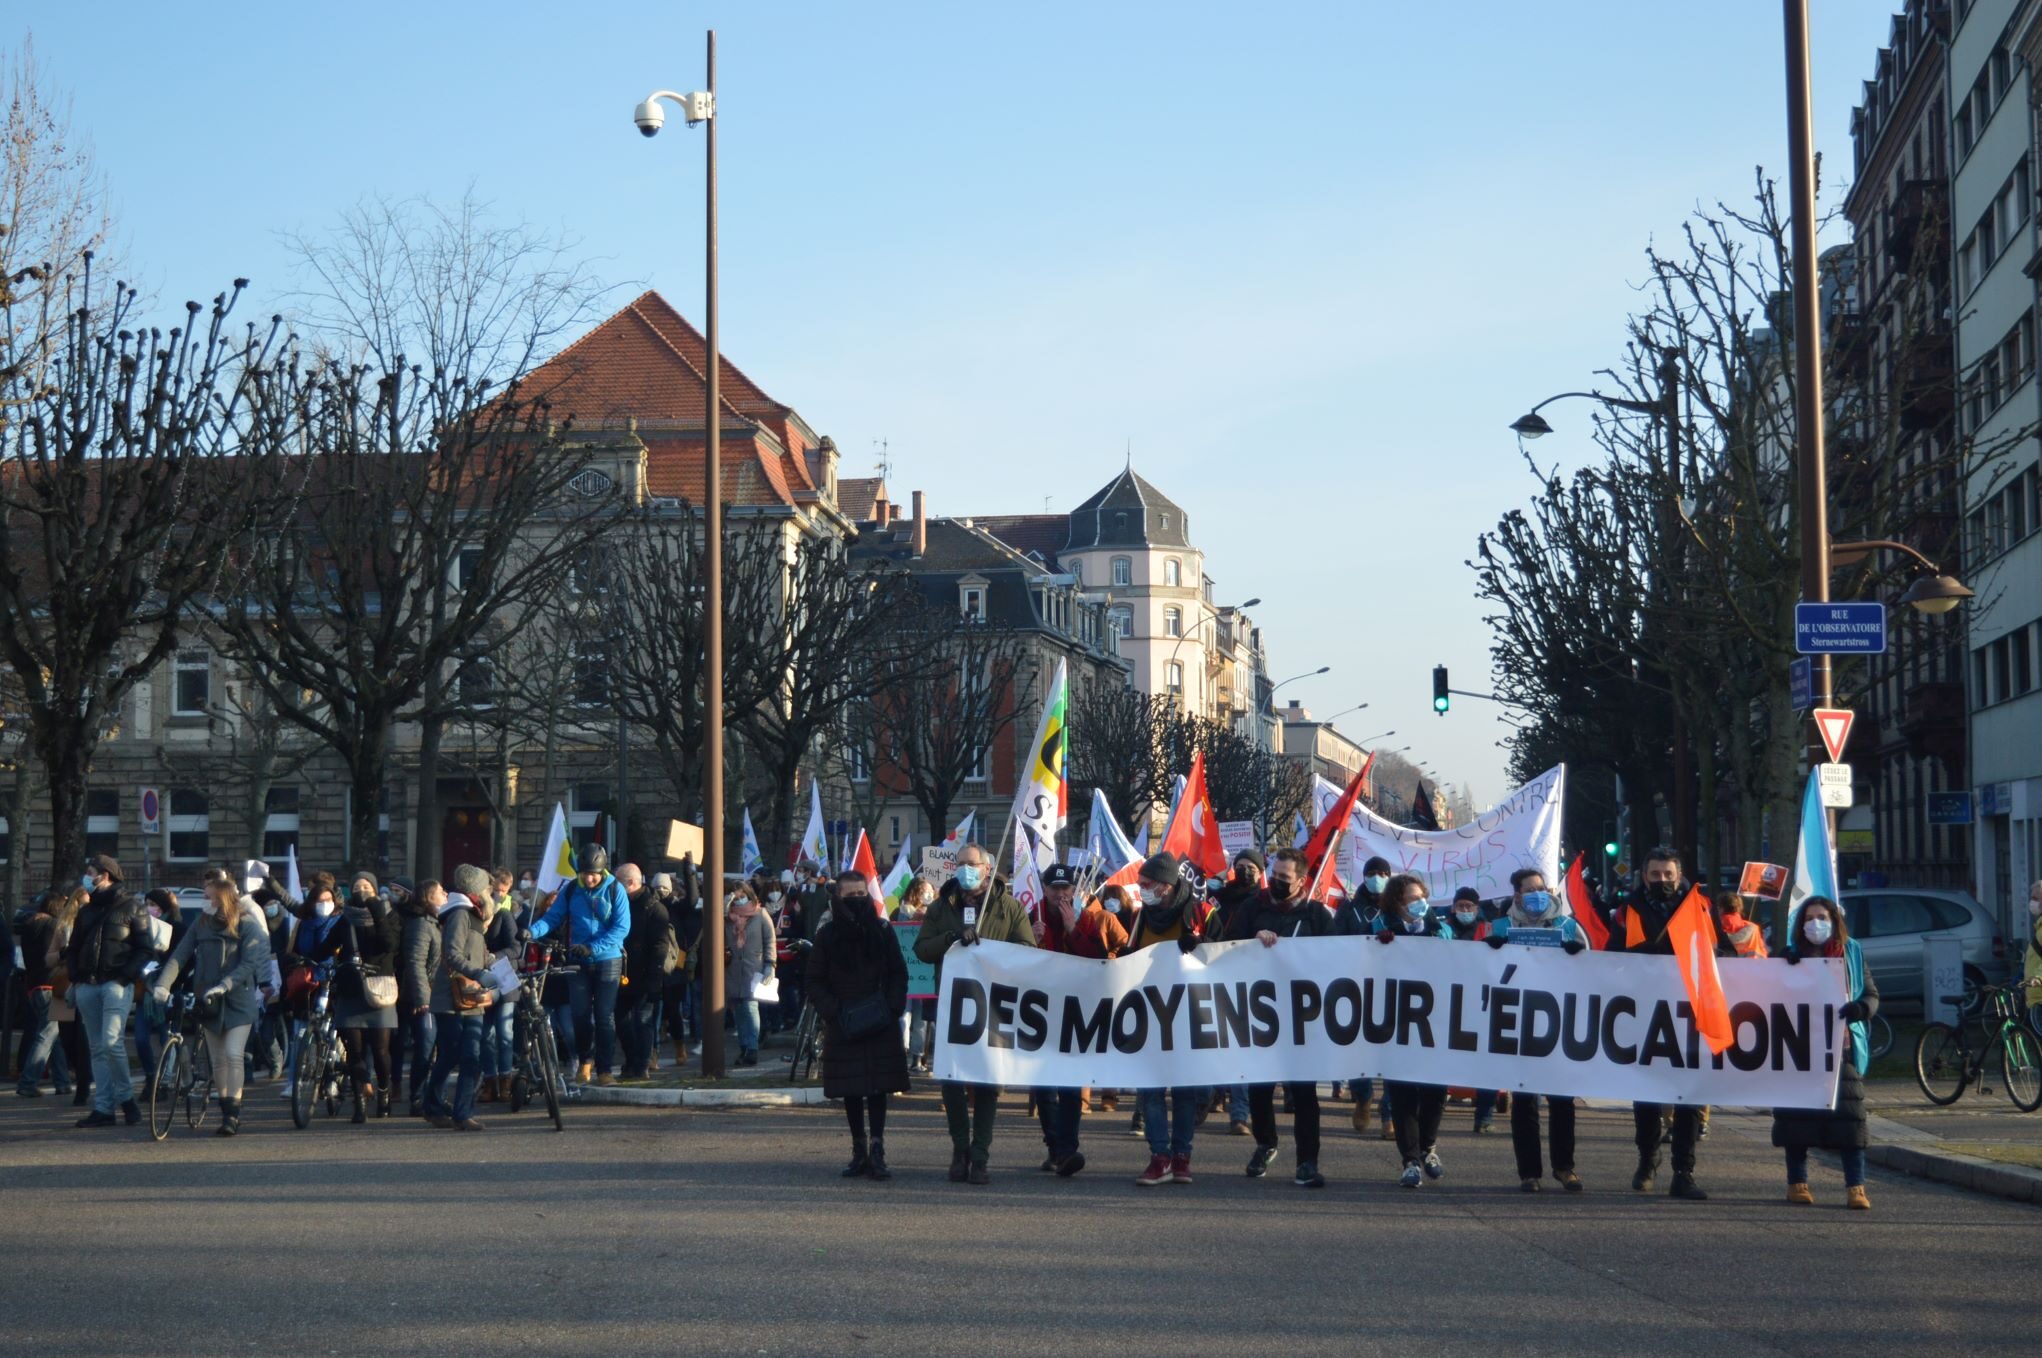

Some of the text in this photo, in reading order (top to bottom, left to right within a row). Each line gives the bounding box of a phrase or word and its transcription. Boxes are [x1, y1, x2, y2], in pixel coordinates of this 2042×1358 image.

[1799, 623, 1881, 633] DE L'OBSERVATOIRE
[1831, 610, 1848, 619] RUE
[1457, 776, 1558, 839] CONTRE
[947, 977, 1048, 1051] DES
[1059, 979, 1280, 1054] MOYENS
[1290, 977, 1434, 1048] POUR
